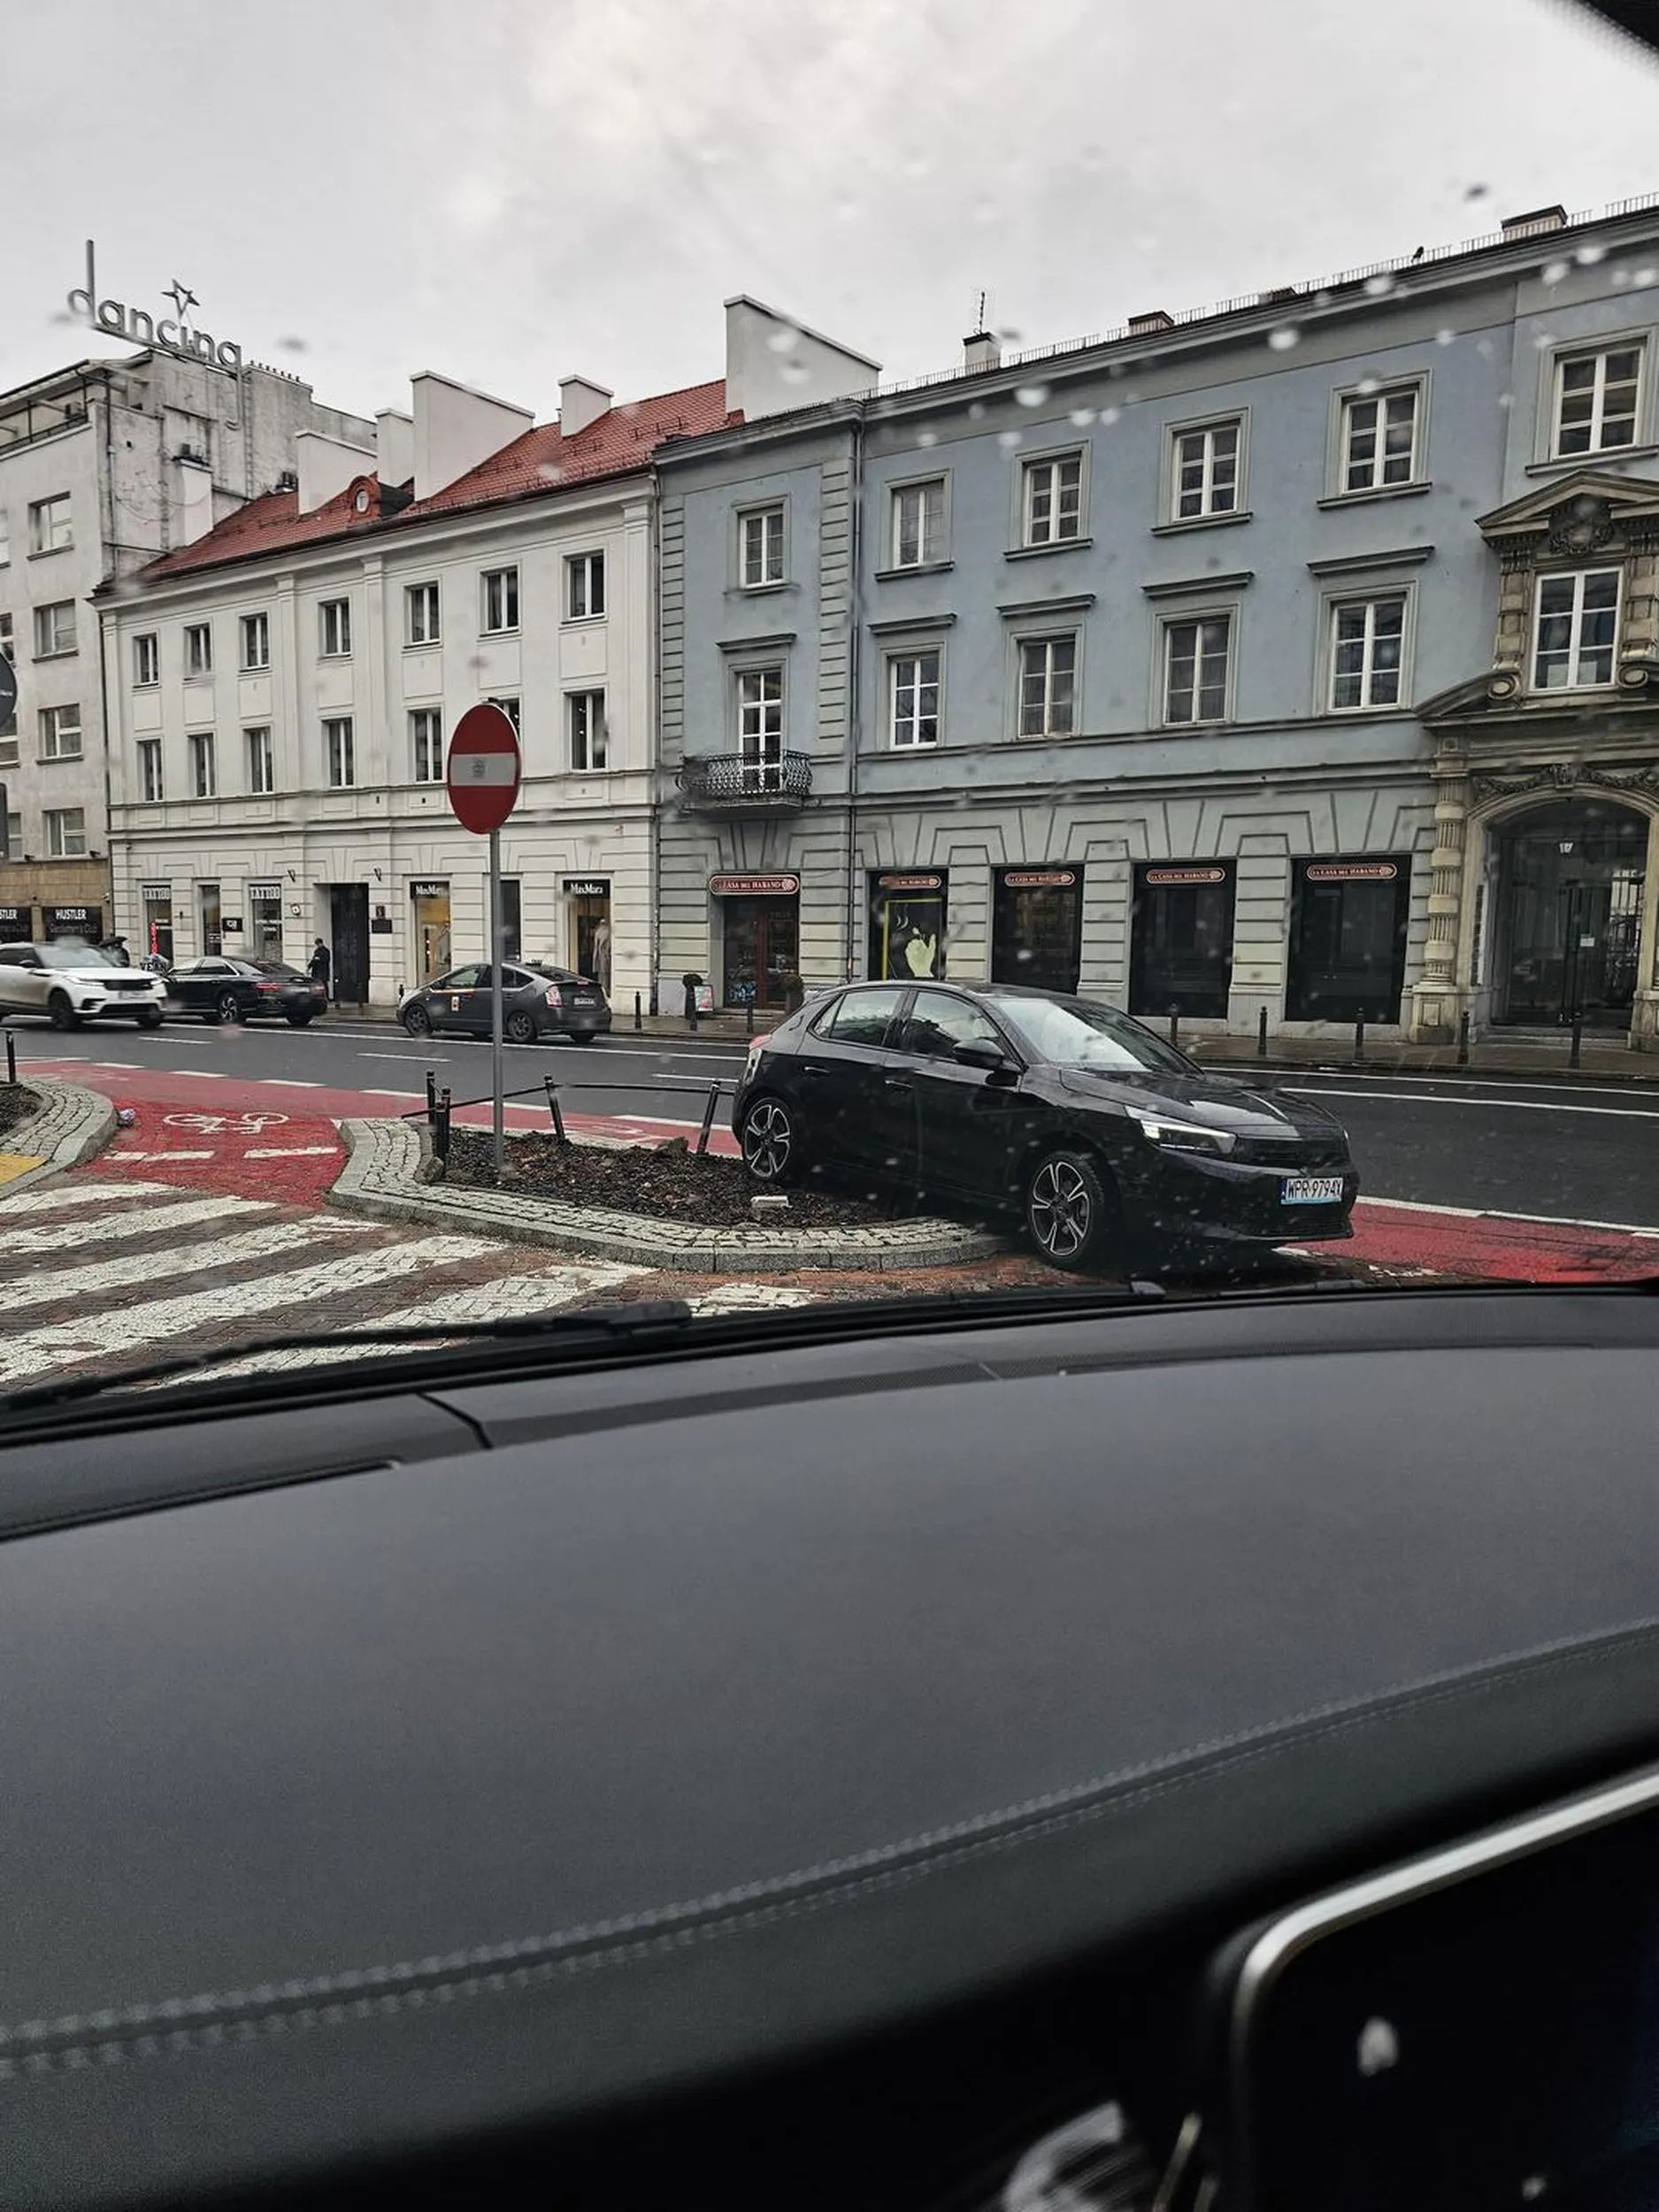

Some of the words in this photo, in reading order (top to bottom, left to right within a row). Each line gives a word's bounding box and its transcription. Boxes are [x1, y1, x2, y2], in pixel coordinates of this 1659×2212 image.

[67, 239, 242, 430] dancing
[250, 887, 280, 900] TATTOO
[55, 909, 87, 920] HUSTLER
[1287, 1179, 1309, 1199] WPR
